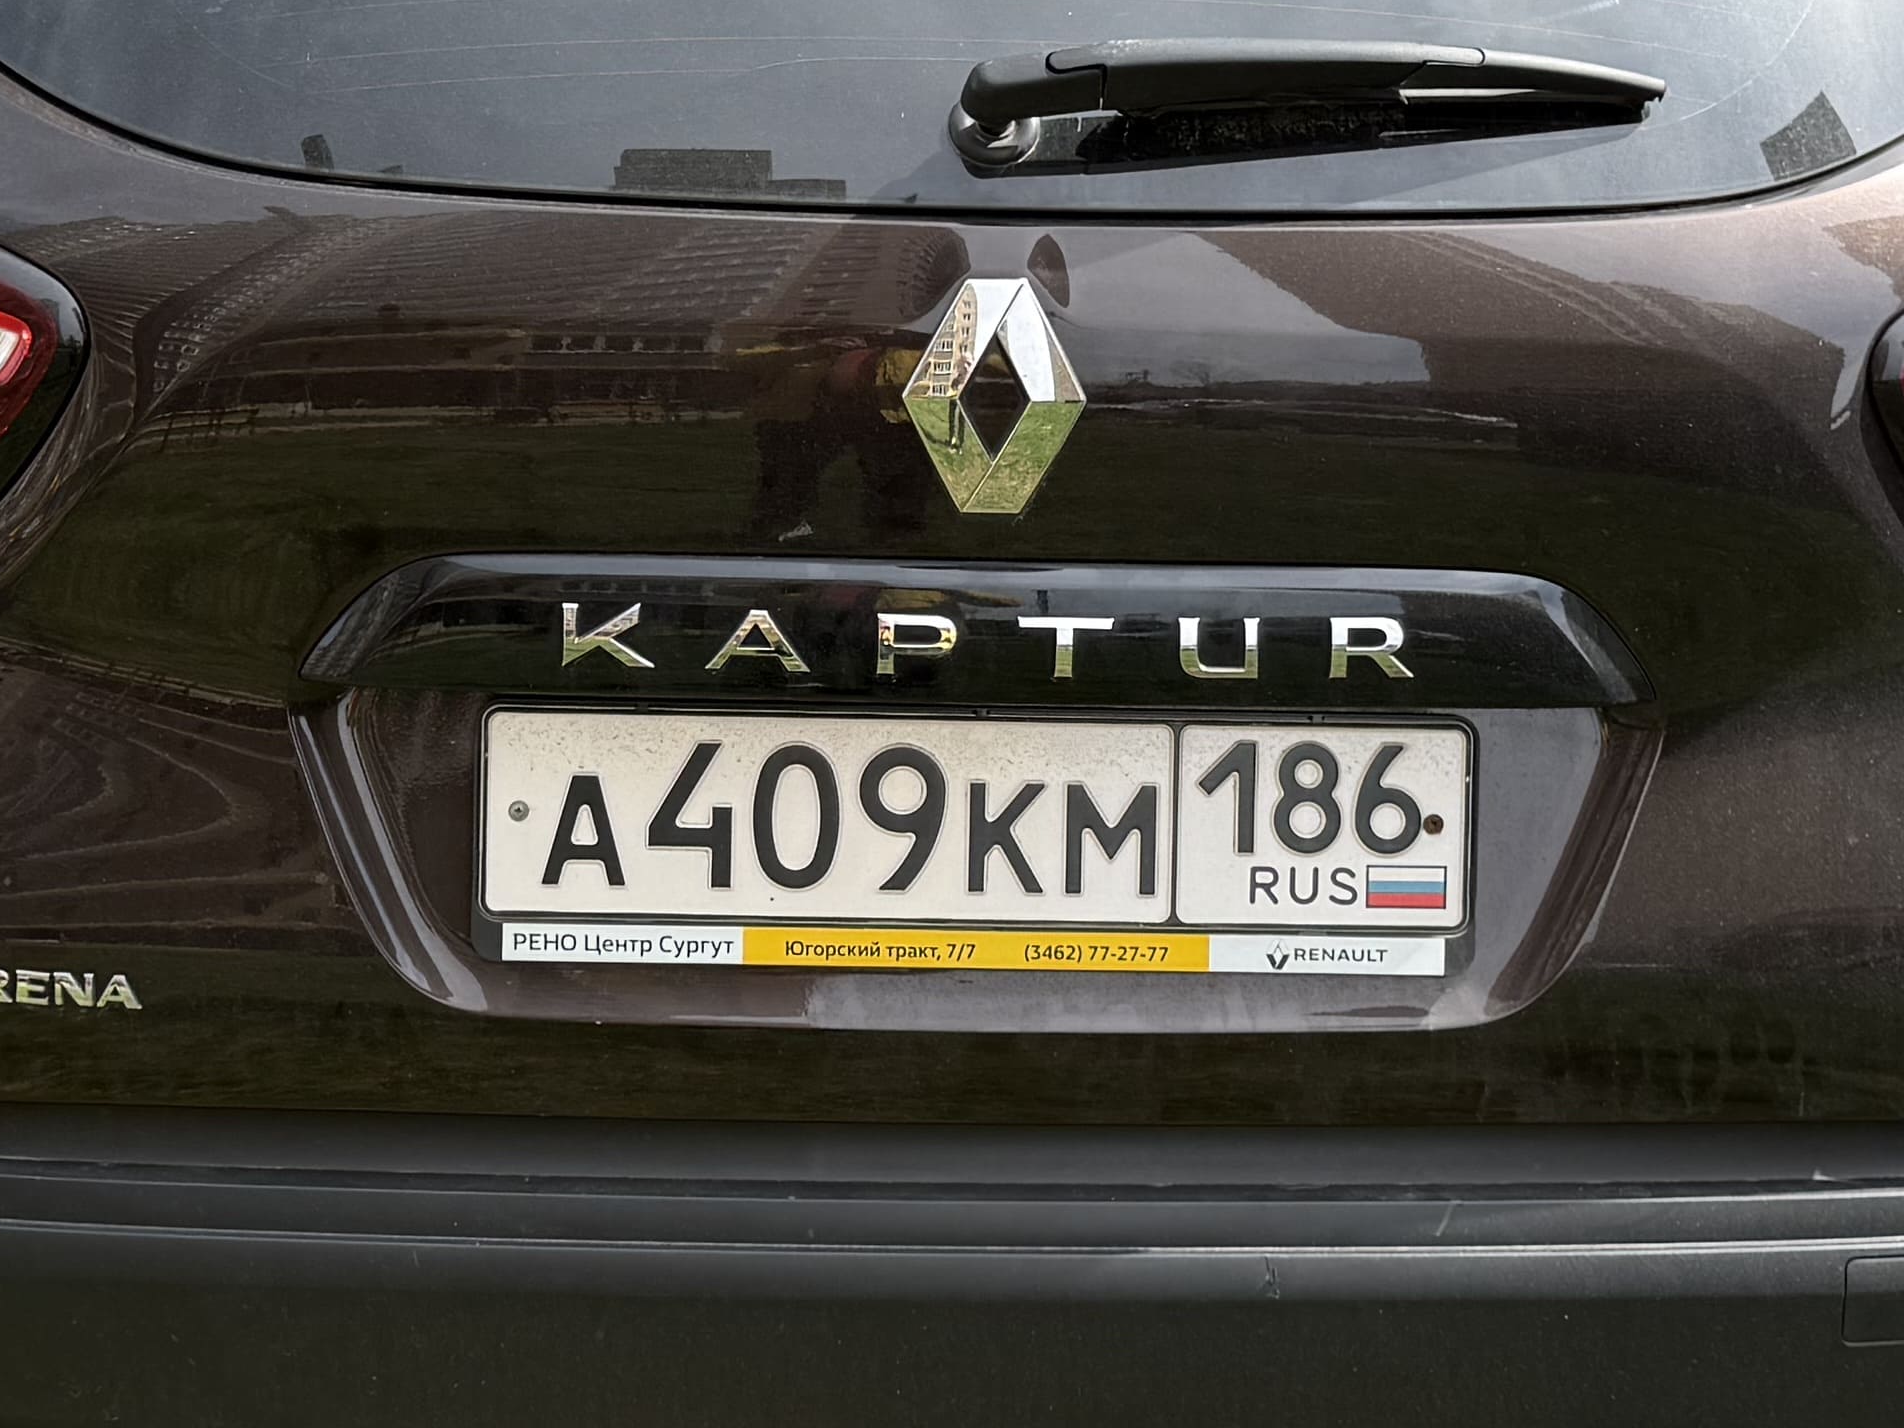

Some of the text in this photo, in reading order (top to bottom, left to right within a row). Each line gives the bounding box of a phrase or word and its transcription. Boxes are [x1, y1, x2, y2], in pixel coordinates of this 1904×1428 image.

[561, 602, 1414, 679] KAPTUR
[541, 739, 1420, 897] А409КМ 186
[1248, 864, 1358, 907] RUS
[512, 933, 734, 958] РЕНО Центр Сургут
[785, 940, 977, 962] Югорский тракт, 7/7
[1023, 944, 1169, 965] (3462) 77-27-77
[1293, 947, 1389, 964] RENAULT
